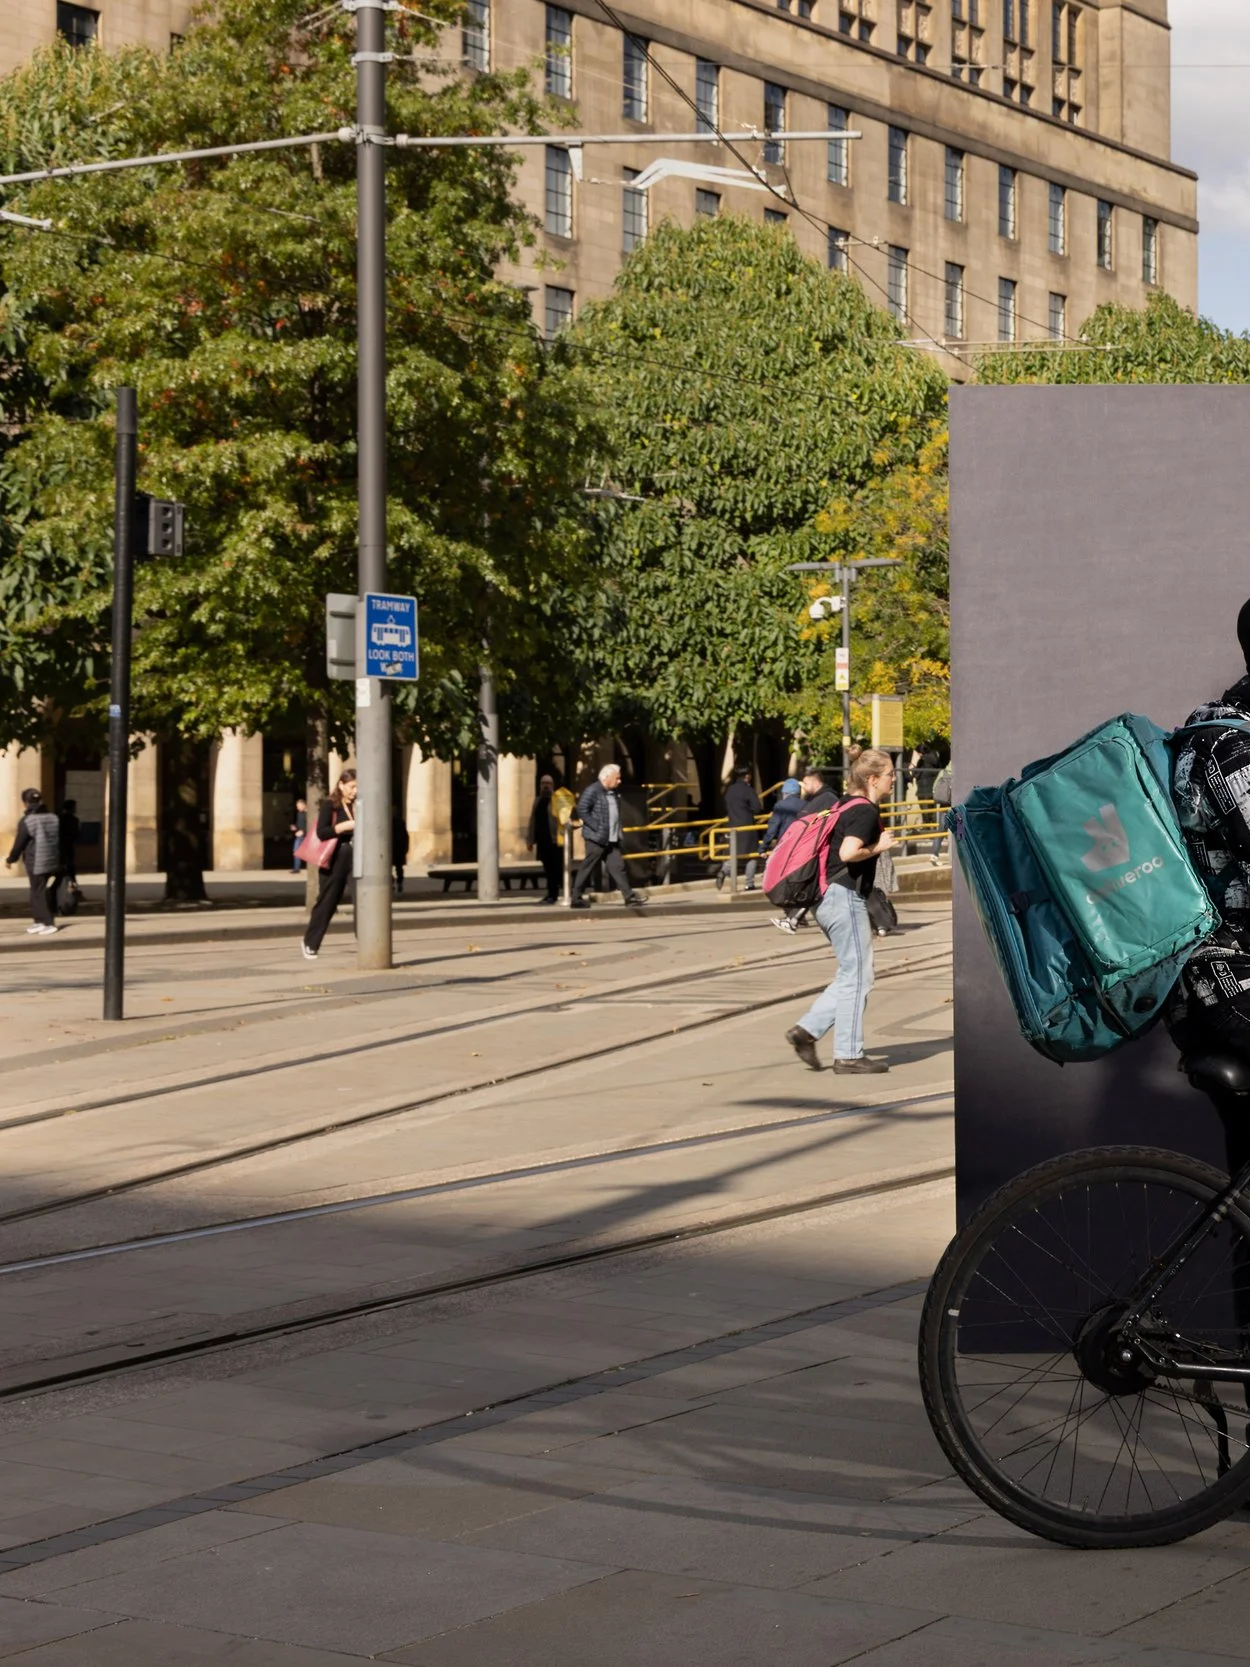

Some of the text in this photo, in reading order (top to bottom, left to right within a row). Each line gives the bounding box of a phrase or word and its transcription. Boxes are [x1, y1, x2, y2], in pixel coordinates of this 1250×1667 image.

[371, 599, 410, 613] TRAMWAY
[368, 649, 415, 662] LOOK BOTH
[1086, 856, 1164, 906] veroo
